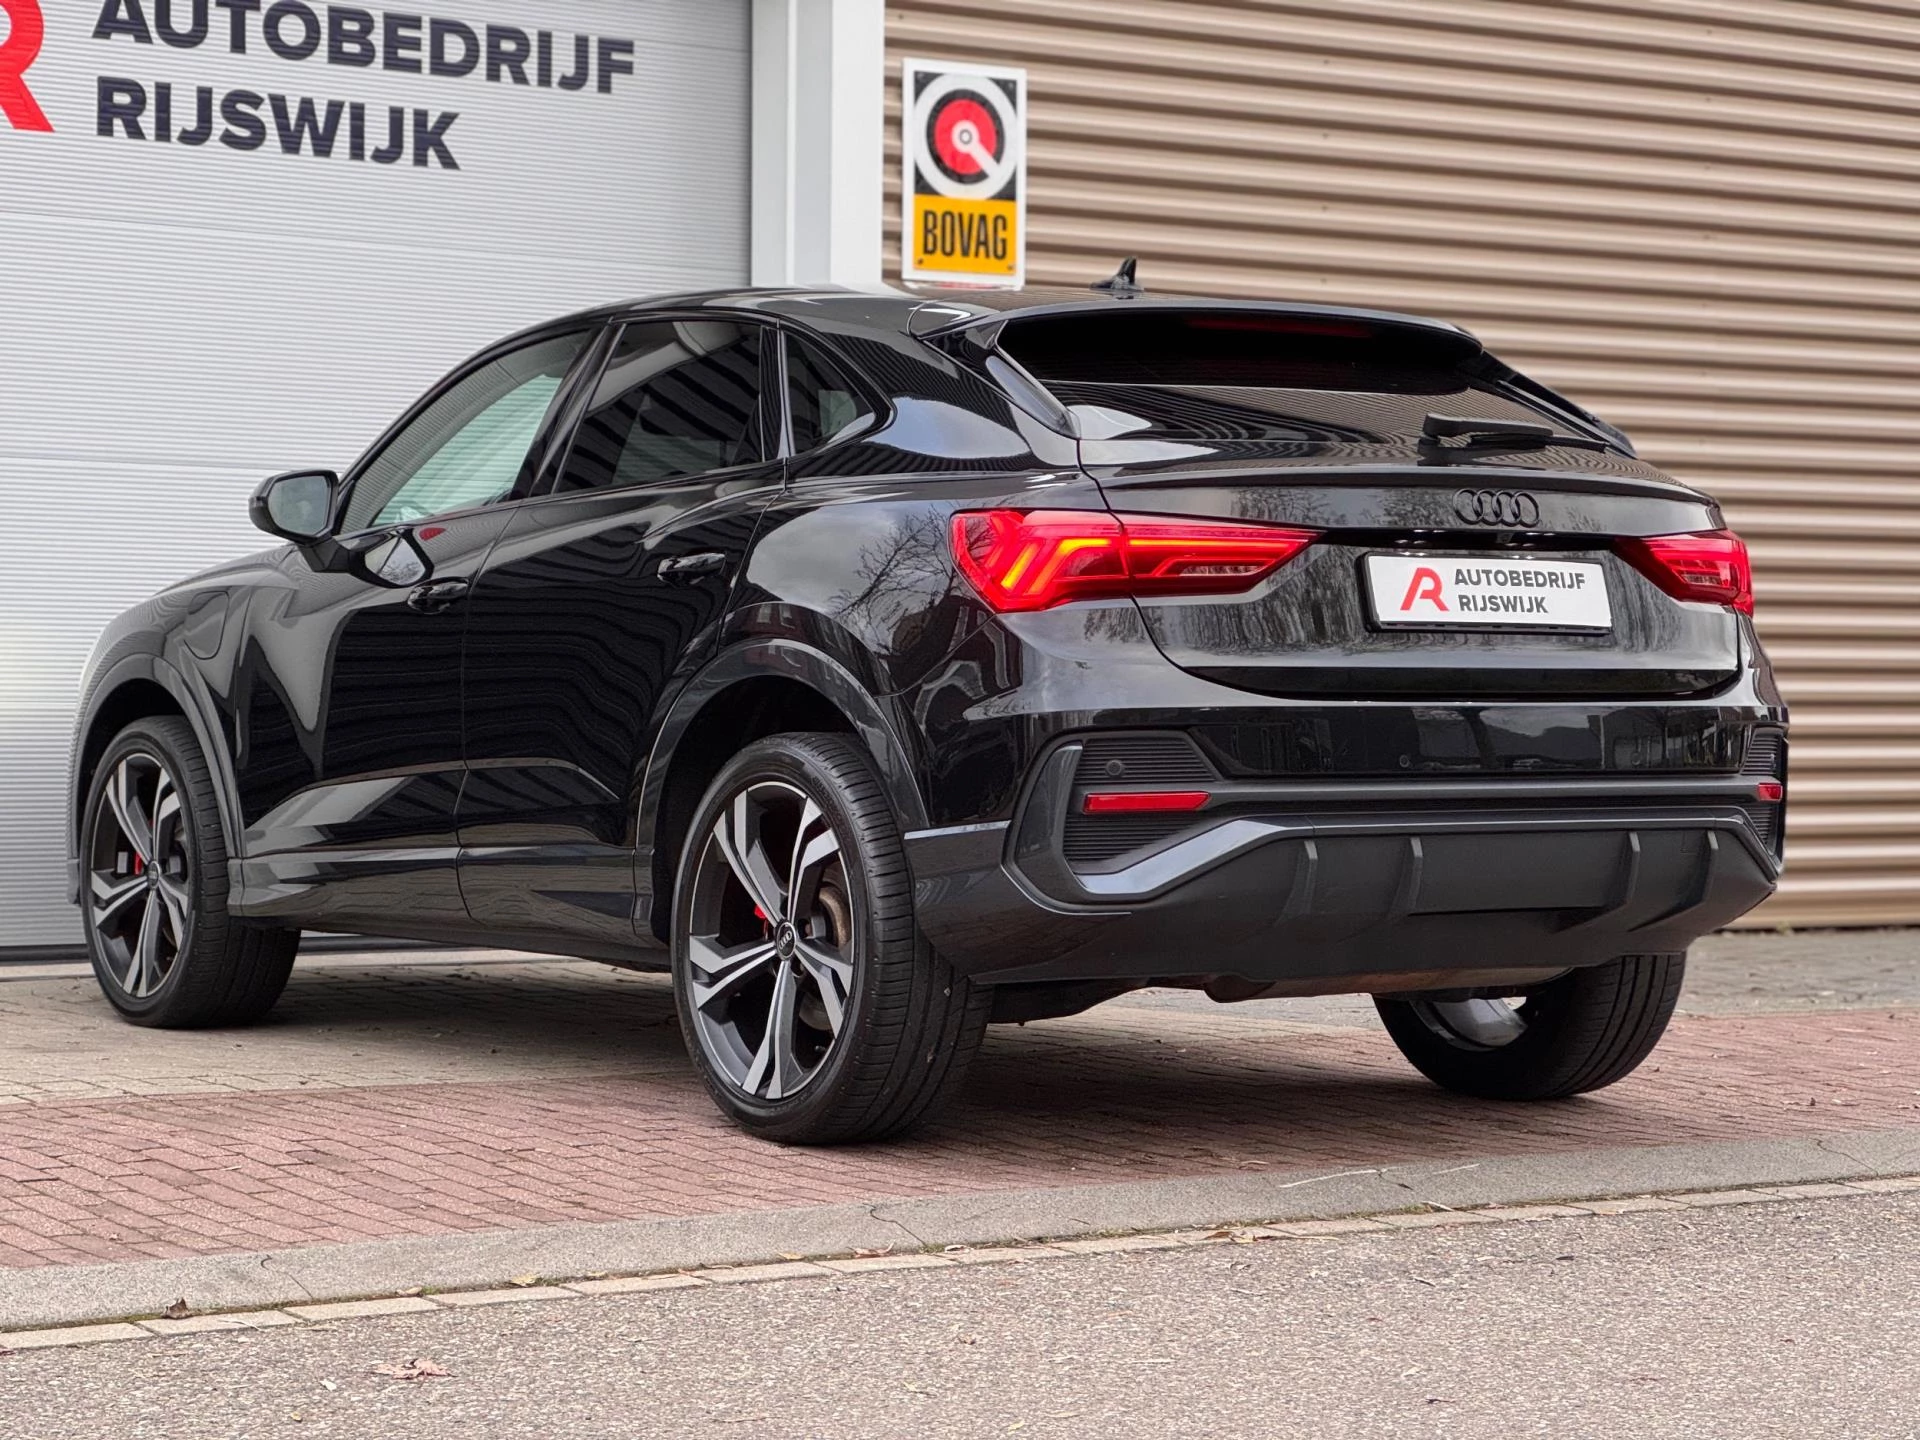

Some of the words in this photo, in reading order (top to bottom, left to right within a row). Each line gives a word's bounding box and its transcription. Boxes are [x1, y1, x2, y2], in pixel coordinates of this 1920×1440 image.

[92, 0, 634, 94] AUTOBEDRIJF
[96, 76, 461, 170] RIJSWIJK
[923, 210, 1007, 260] BOVAG
[1454, 568, 1585, 589] AUTOBEDRIJF
[1458, 595, 1548, 613] RIJSWIJK
